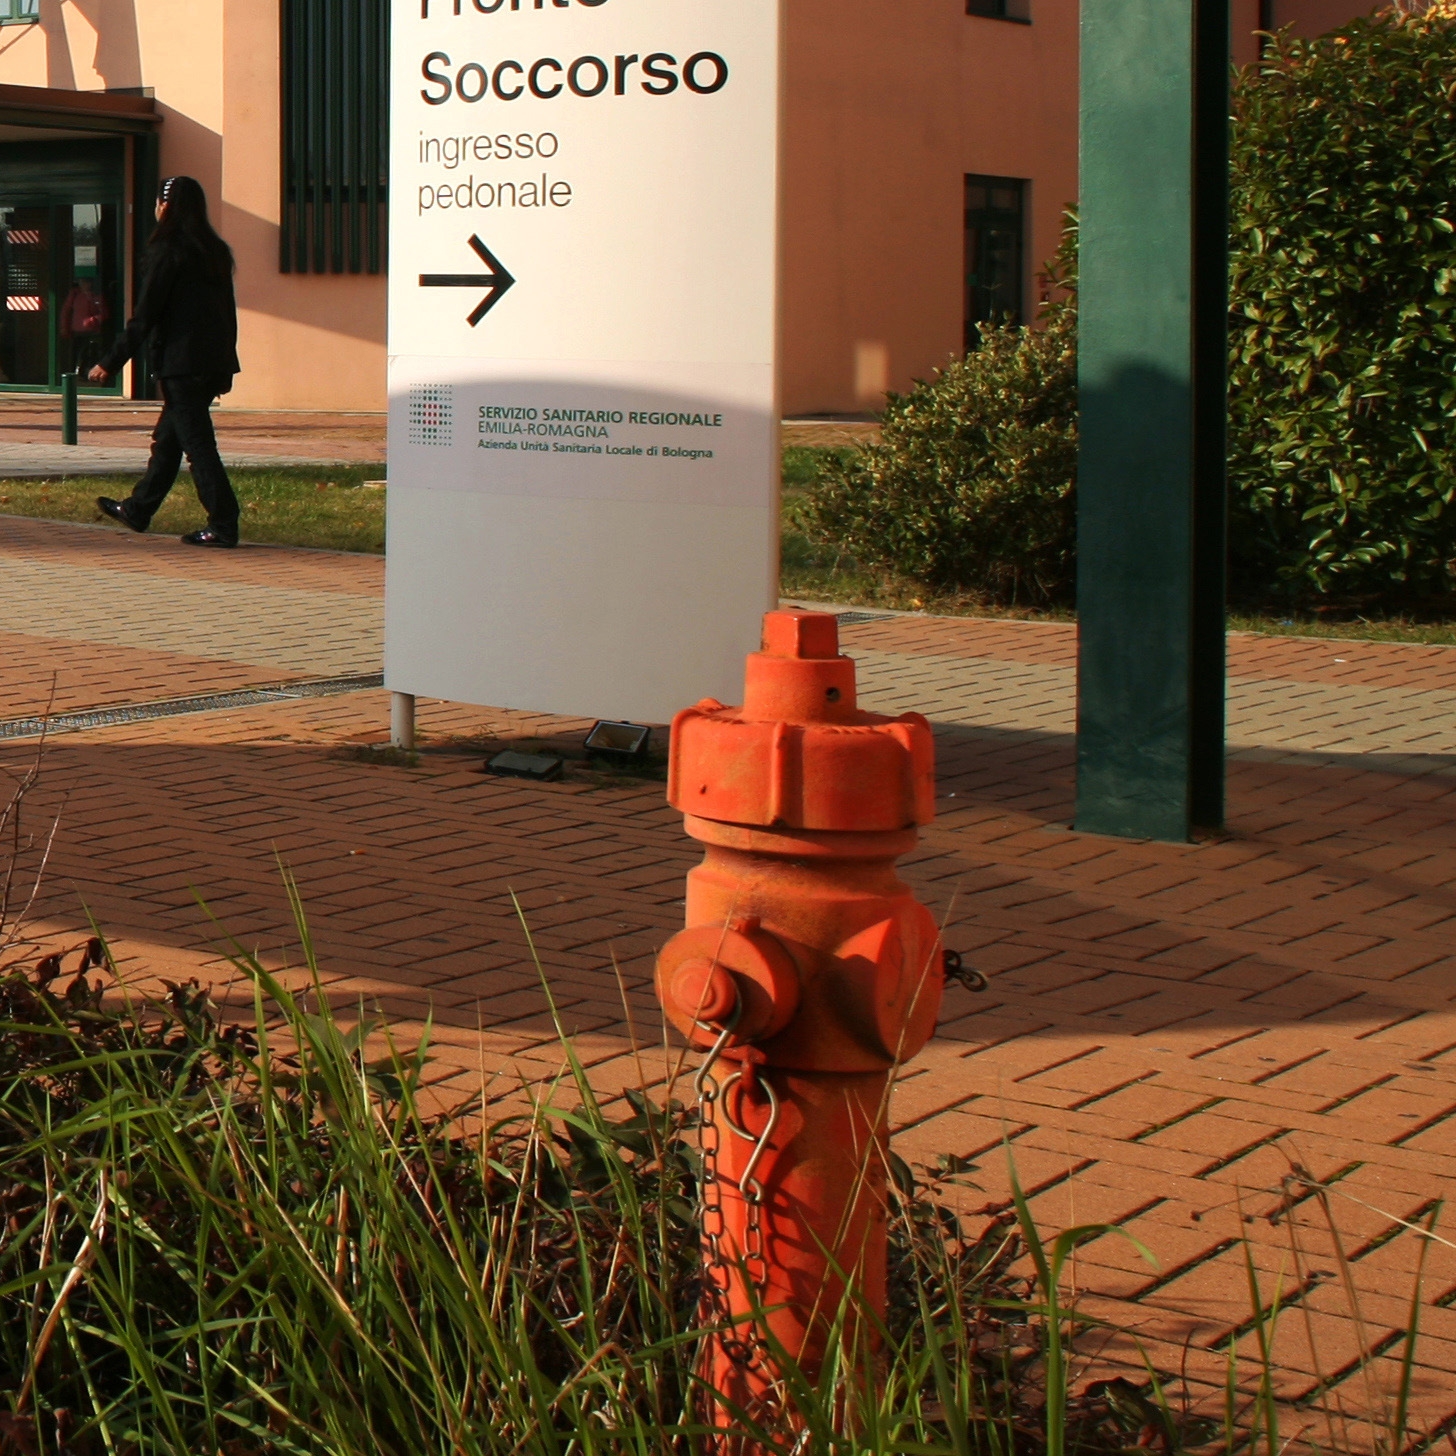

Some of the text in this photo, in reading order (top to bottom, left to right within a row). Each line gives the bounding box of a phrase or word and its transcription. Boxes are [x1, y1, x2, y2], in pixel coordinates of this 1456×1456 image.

[420, 50, 729, 106] Soccorso
[419, 130, 559, 170] ingresso
[418, 173, 573, 217] pedonale
[478, 405, 723, 427] SERVIZIO SANITARIO REGIONALE
[478, 420, 609, 438] EMILIA-ROMAGNA
[477, 438, 714, 460] Azienda Unità Sanitaria Locale di Bologna
